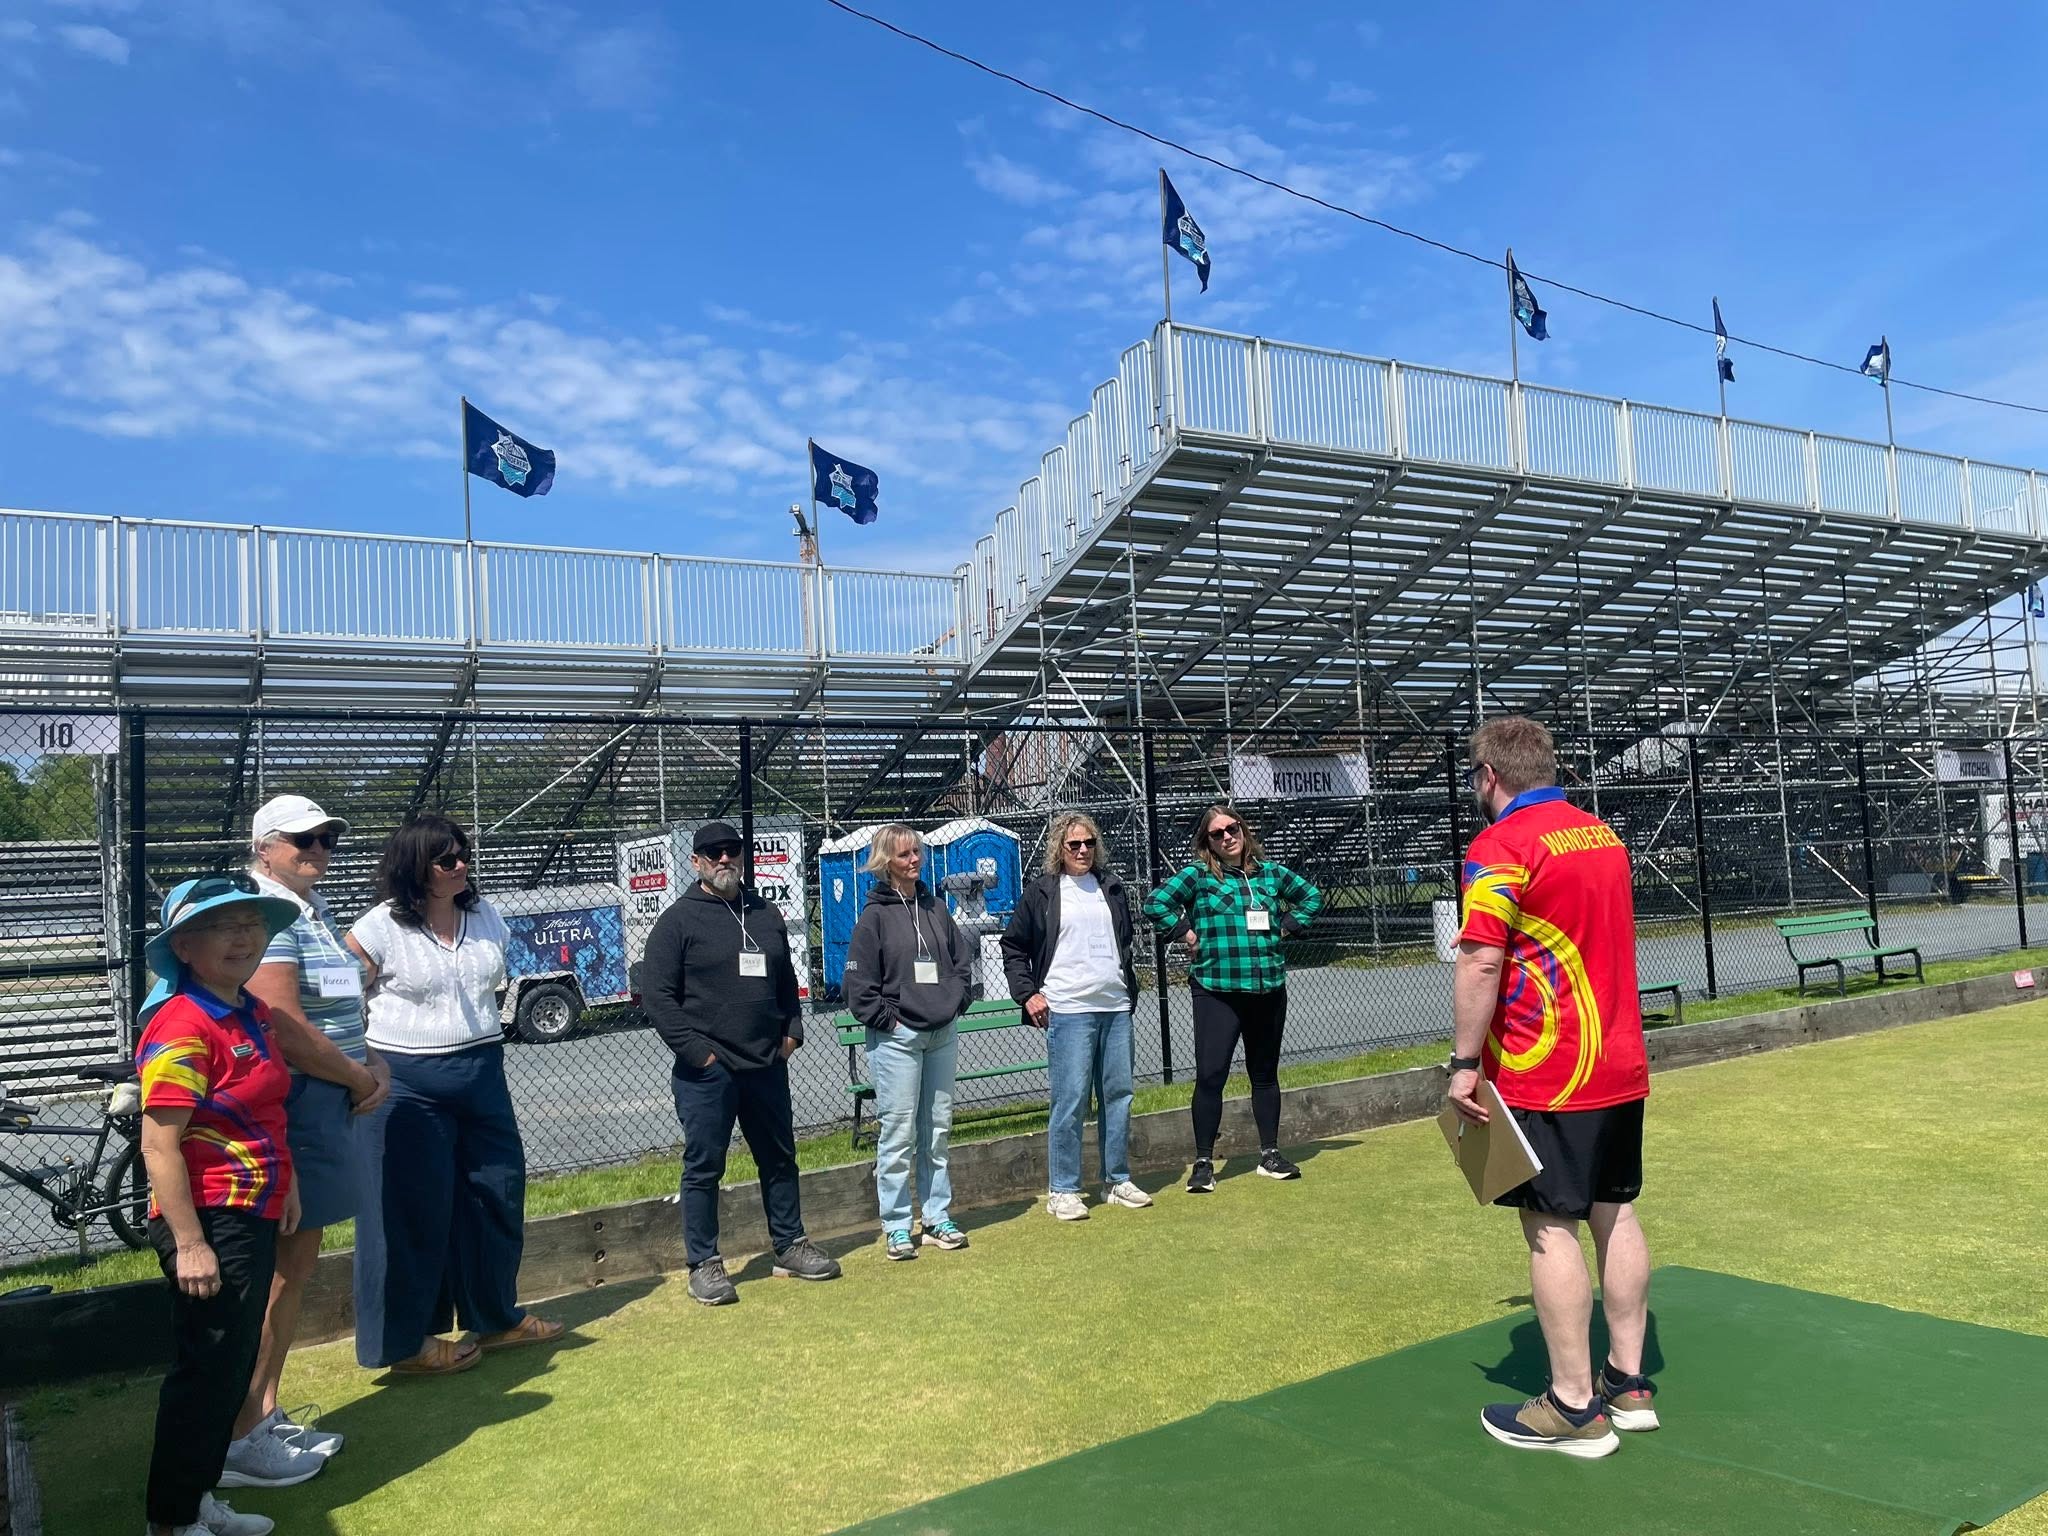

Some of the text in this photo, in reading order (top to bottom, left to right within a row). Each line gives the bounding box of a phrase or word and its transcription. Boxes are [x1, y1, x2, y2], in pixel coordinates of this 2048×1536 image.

[40, 723, 73, 748] 110
[1273, 771, 1332, 793] KITCHEN
[753, 840, 786, 853] AUL
[629, 847, 665, 873] U-HAUL
[534, 926, 594, 946] ULTRA
[322, 975, 351, 987] Noreen
